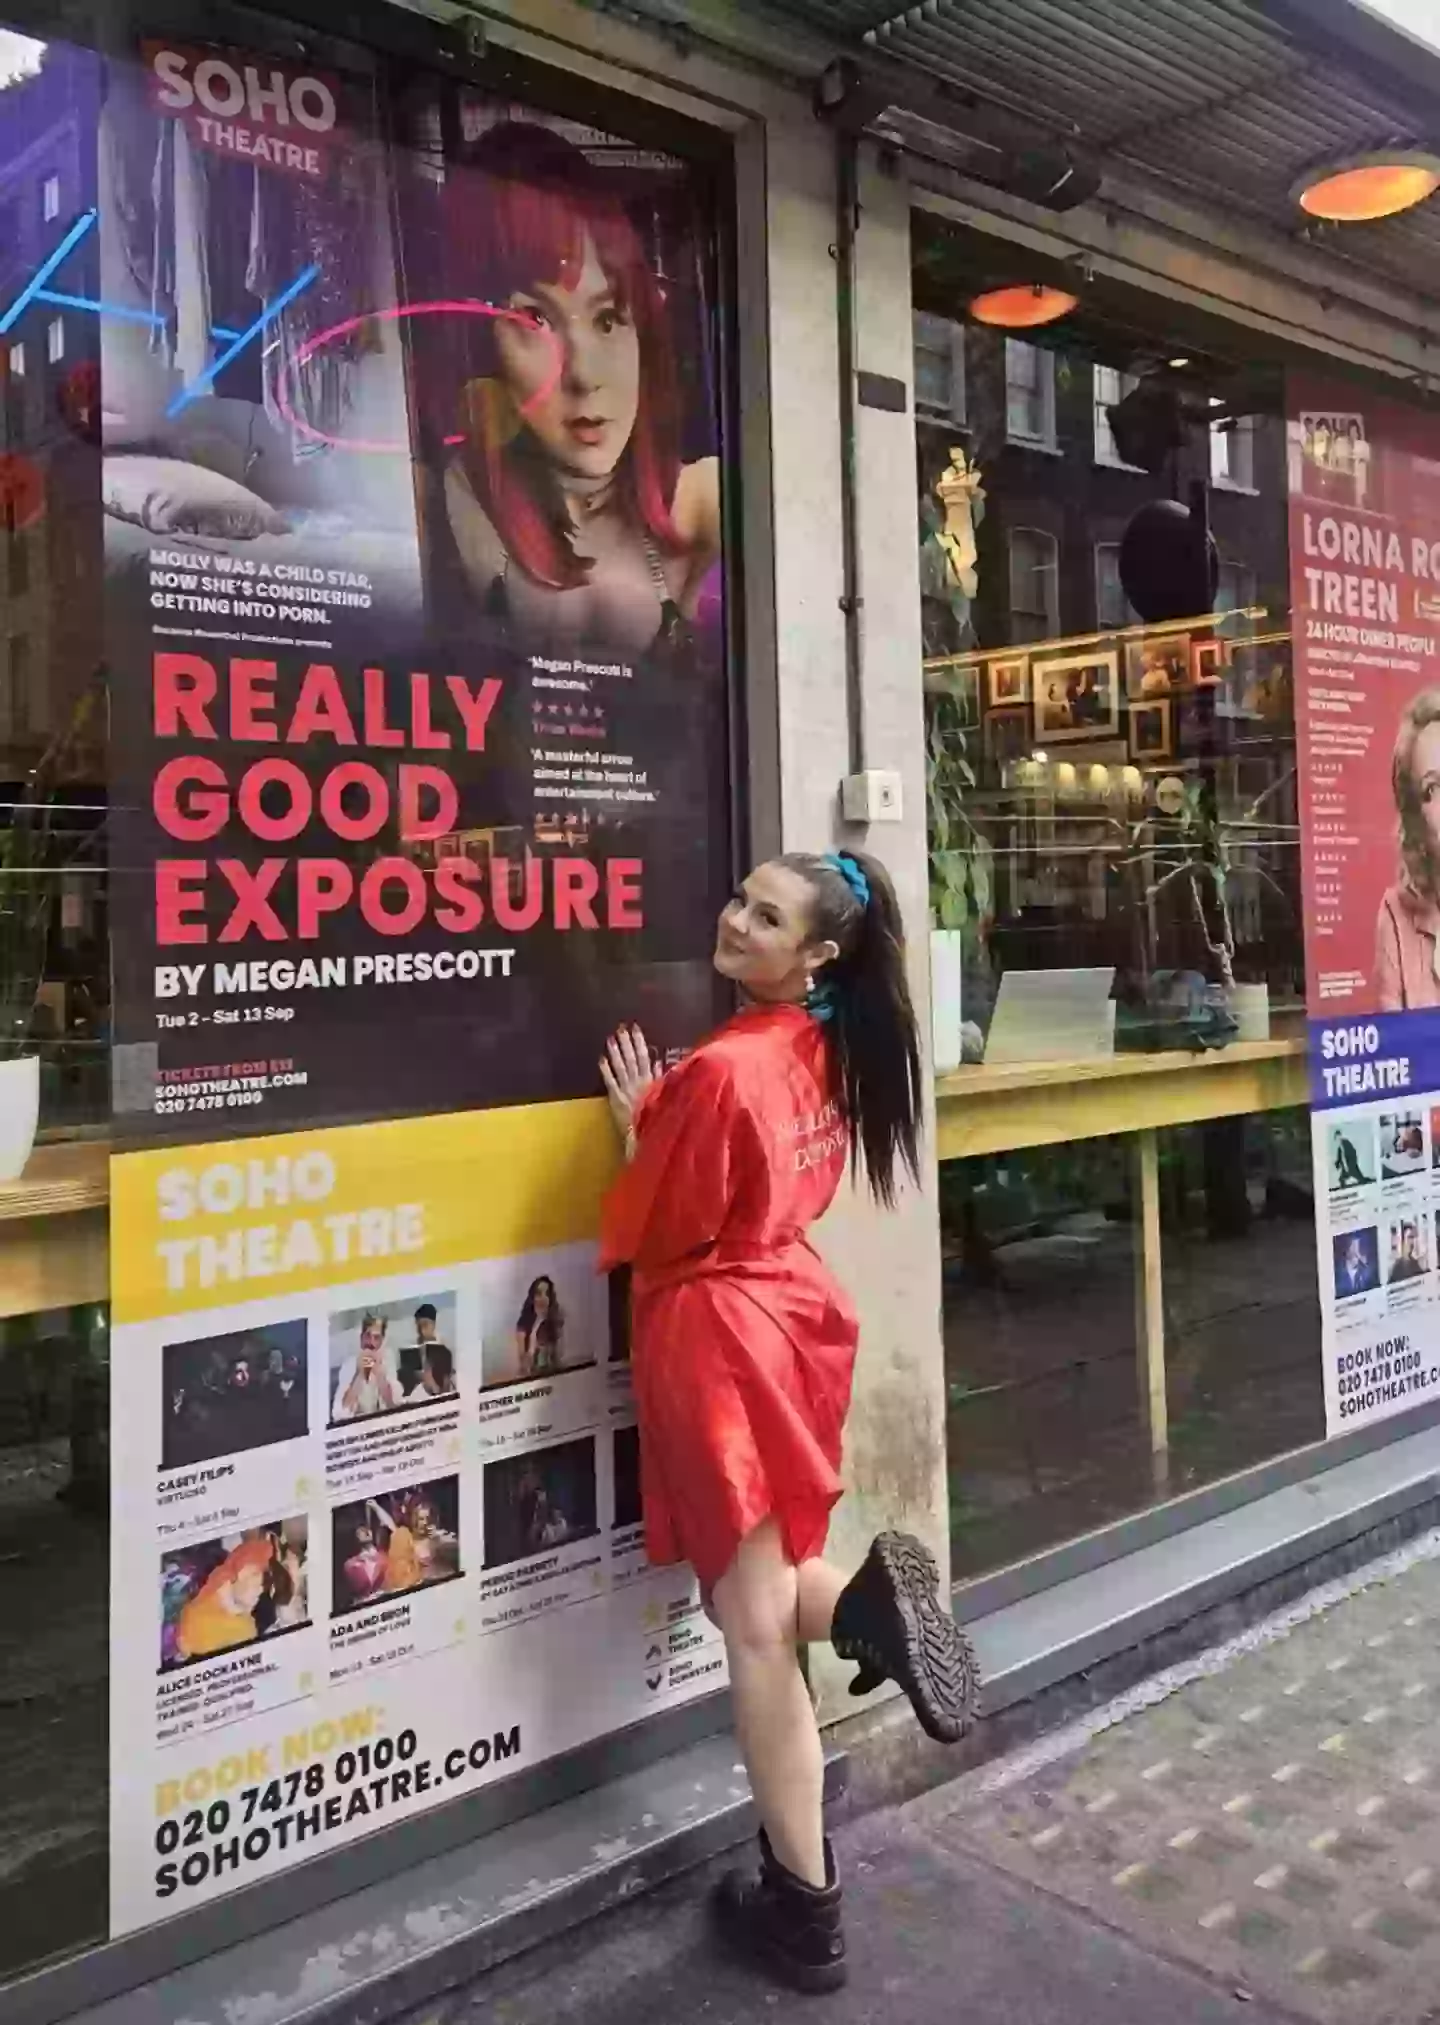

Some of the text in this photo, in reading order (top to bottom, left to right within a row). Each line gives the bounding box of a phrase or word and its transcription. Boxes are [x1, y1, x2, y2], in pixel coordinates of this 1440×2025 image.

[153, 50, 337, 132] SOHO
[197, 116, 321, 174] THEATRE
[149, 548, 210, 570] MOLLY
[214, 557, 255, 576] WAS
[259, 565, 272, 579] A
[274, 565, 325, 584] CHILD
[1304, 513, 1405, 573] LORNA
[150, 571, 373, 609] NOW SHE'S CONSIDERING
[150, 592, 332, 625] GETTING INTO PORN.
[1304, 567, 1399, 623] TREEN
[153, 652, 503, 752] REALLY
[152, 755, 461, 842] GOOD
[154, 857, 645, 945] EXPOSURE
[154, 949, 516, 998] BY MEGAN PRESCOTT
[155, 1013, 186, 1029] Tue
[187, 1011, 200, 1027] 2
[213, 1009, 240, 1024] Sat
[243, 1007, 262, 1022] 13
[264, 1006, 296, 1022] Sep
[1321, 1024, 1380, 1060] SOHO
[155, 1071, 308, 1099] SOHOTHEATRE.COM
[1322, 1057, 1410, 1098] THEATRE
[155, 1091, 263, 1114] 020 7478 0100
[156, 1150, 337, 1222] SOHO
[157, 1202, 425, 1293] THEATRE
[1337, 1335, 1410, 1375] BOOK NOW:
[1338, 1351, 1421, 1396] 020 7478 0100
[1340, 1367, 1440, 1418] SOHOTHEATRE.C
[156, 1472, 198, 1493] CASEY
[330, 1623, 354, 1639] ADA
[356, 1615, 379, 1631] AND
[156, 1652, 263, 1697] ALICE COCKAYNE
[155, 1704, 387, 1817] BOOK NOW:
[155, 1729, 417, 1857] 020 7478 0100
[155, 1725, 523, 1898] SOHOTHEATRE.COM
